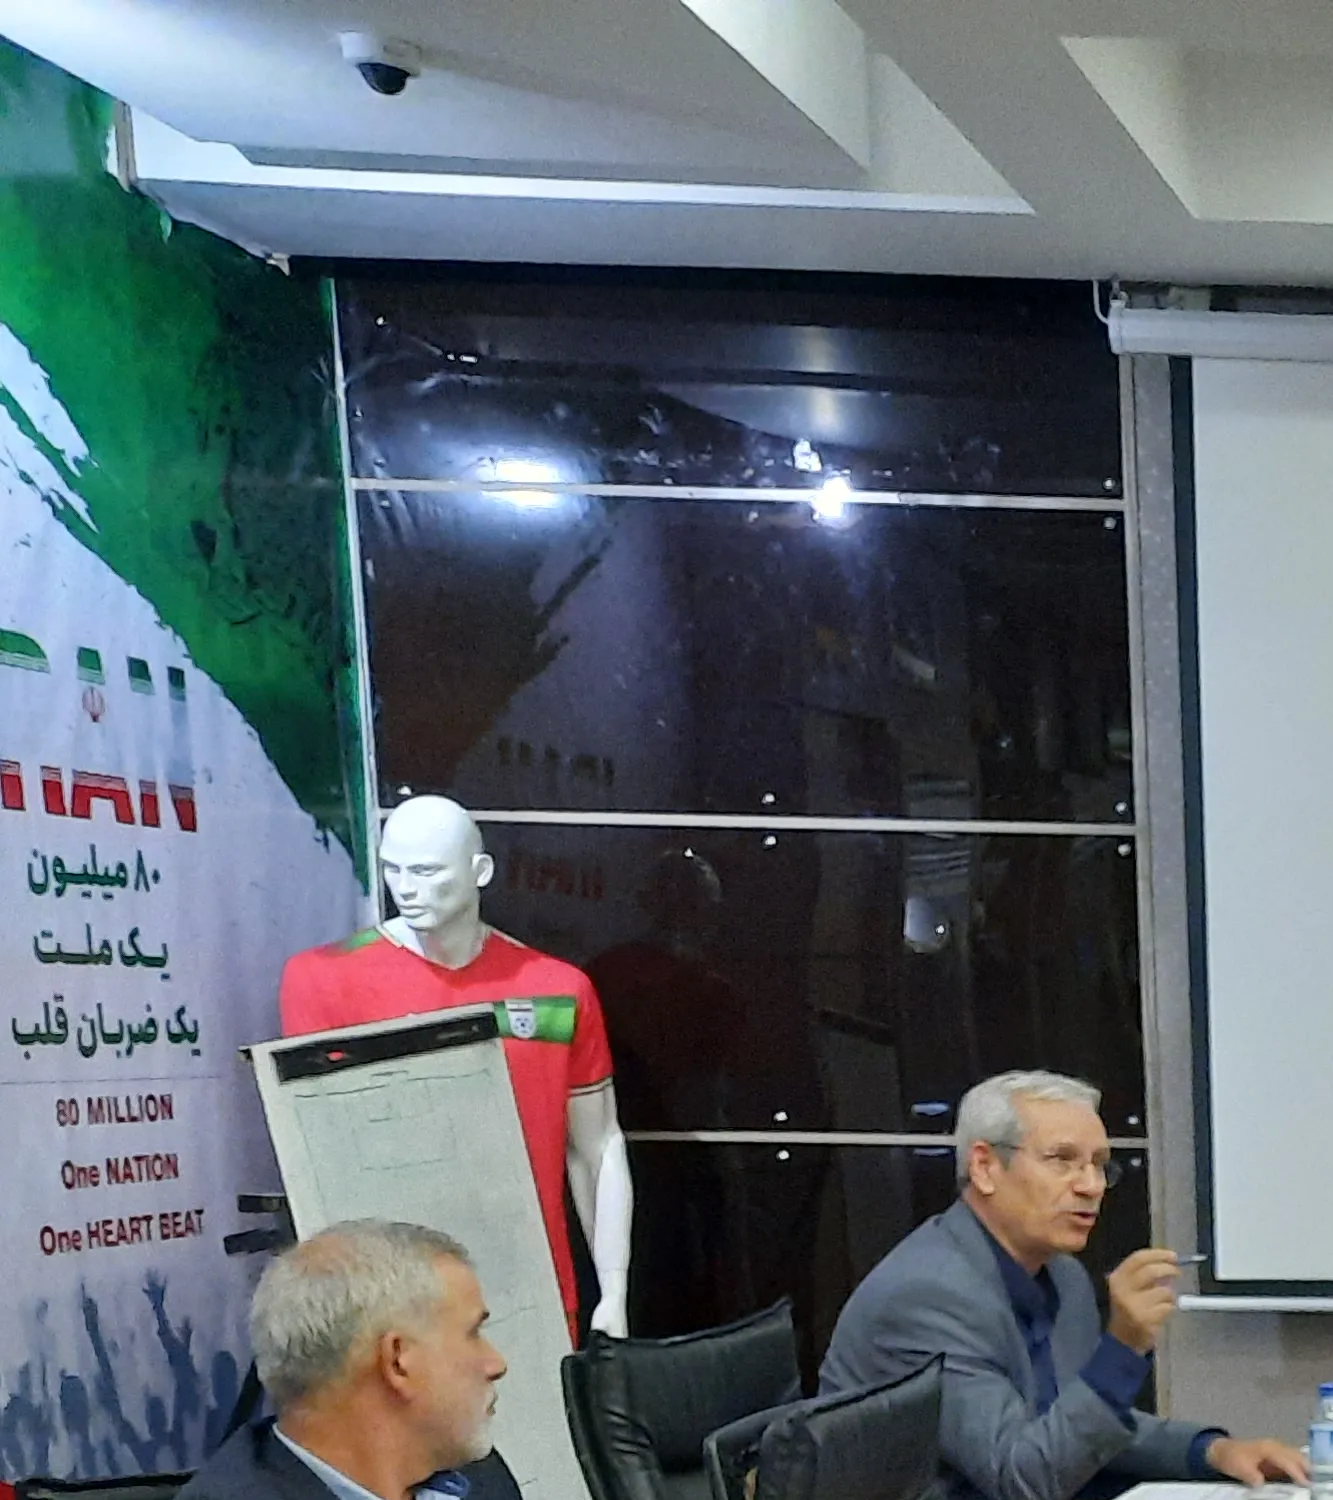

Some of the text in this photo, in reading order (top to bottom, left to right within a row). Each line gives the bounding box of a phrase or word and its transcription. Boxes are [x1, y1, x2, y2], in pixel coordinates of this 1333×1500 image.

[28, 844, 128, 898] میلیون
[33, 923, 171, 980] یک ملت
[12, 994, 201, 1060] یک ضربان قلب
[56, 1094, 174, 1126] 80 MILLION
[61, 1153, 179, 1189] One NATION
[40, 1209, 204, 1256] One HEART BEAT
